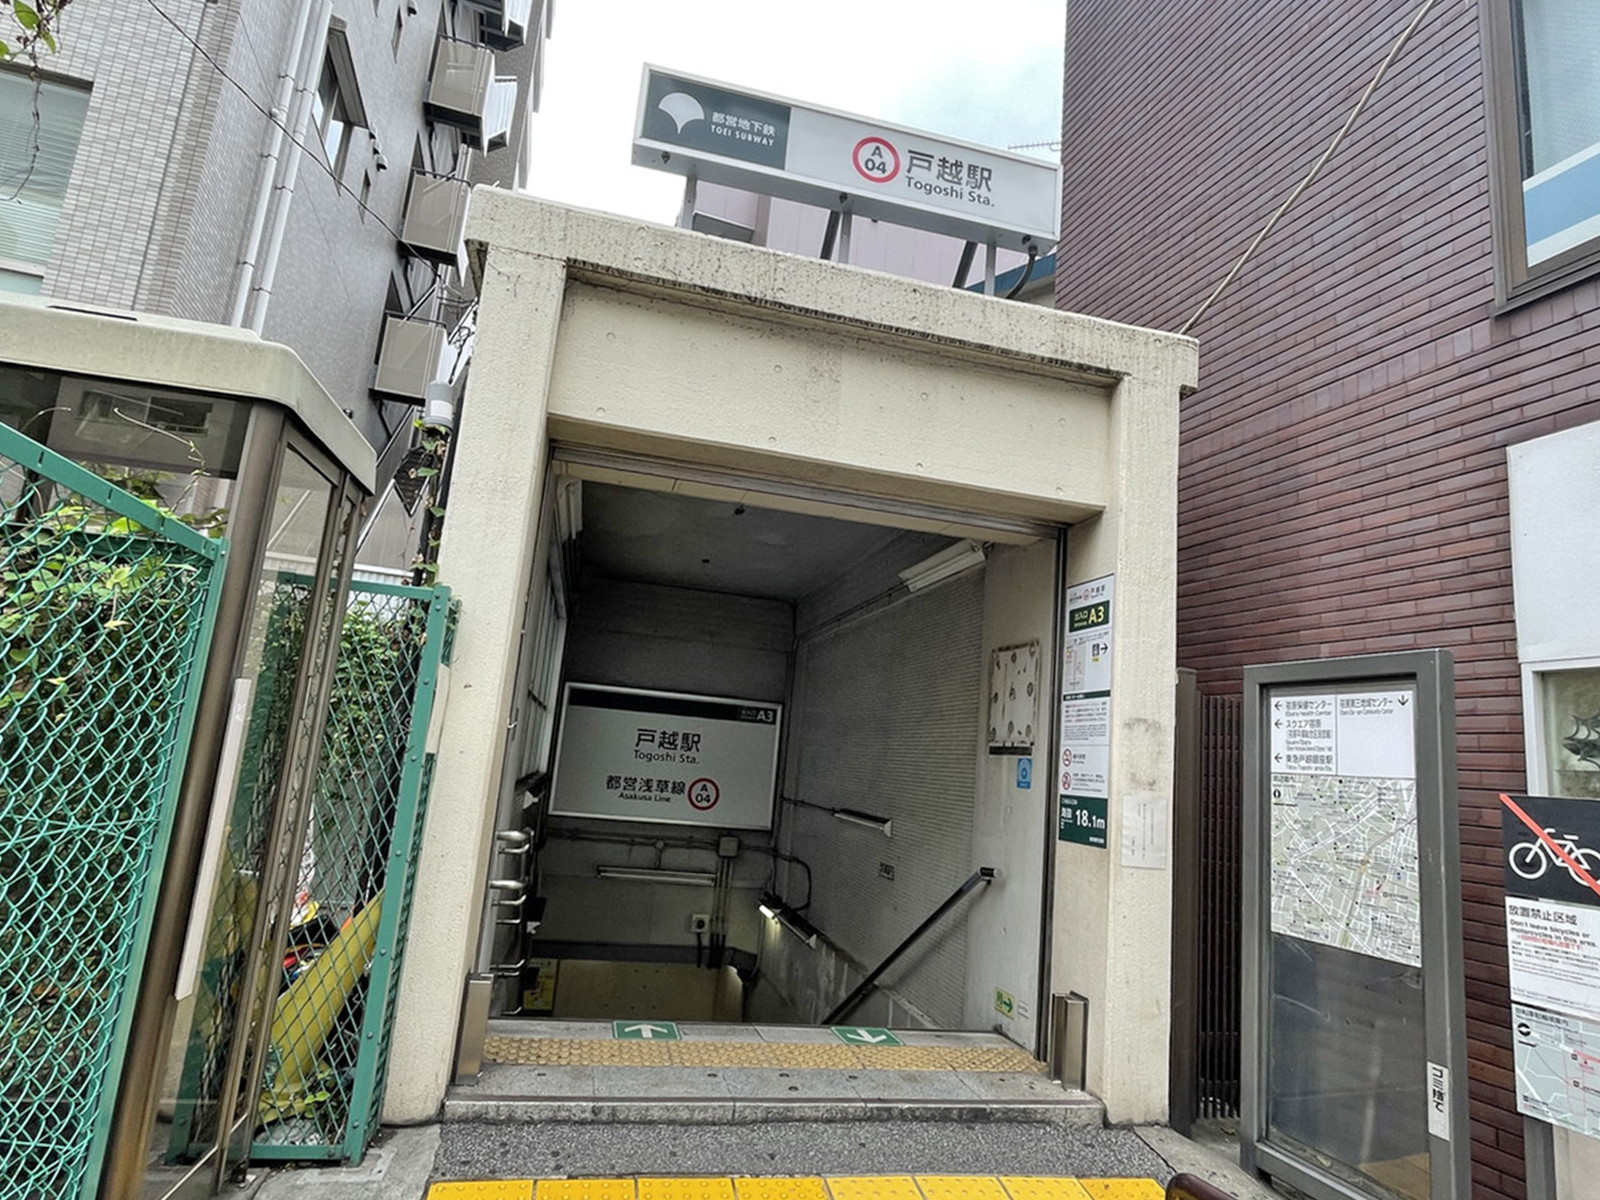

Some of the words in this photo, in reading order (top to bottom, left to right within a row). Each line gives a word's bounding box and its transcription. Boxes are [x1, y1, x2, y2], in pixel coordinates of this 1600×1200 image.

[712, 112, 776, 137] 都営地下鉄
[711, 125, 732, 137] TOEI
[735, 130, 775, 147] SUBWAY
[871, 145, 883, 159] A
[864, 158, 887, 174] 04
[906, 149, 993, 193] 戸越駅
[905, 175, 964, 200] Togoshi
[968, 190, 995, 208] Sta.
[1089, 605, 1105, 624] A3
[756, 709, 774, 722] A3
[635, 728, 702, 753] 戸越駅
[633, 750, 676, 762] Togoshi
[680, 753, 700, 765] Sta.
[606, 775, 686, 796] 都営浅草線
[700, 784, 708, 792] A
[618, 792, 652, 802] Asakusa
[654, 794, 672, 804] Line
[695, 793, 711, 804] 04
[1076, 809, 1105, 829] 18.1m
[1509, 905, 1577, 926] 放置禁止区域
[1510, 927, 1553, 939] motorcycles
[1563, 935, 1577, 943] this
[1530, 923, 1548, 931] leave
[1550, 926, 1580, 937] bicycles
